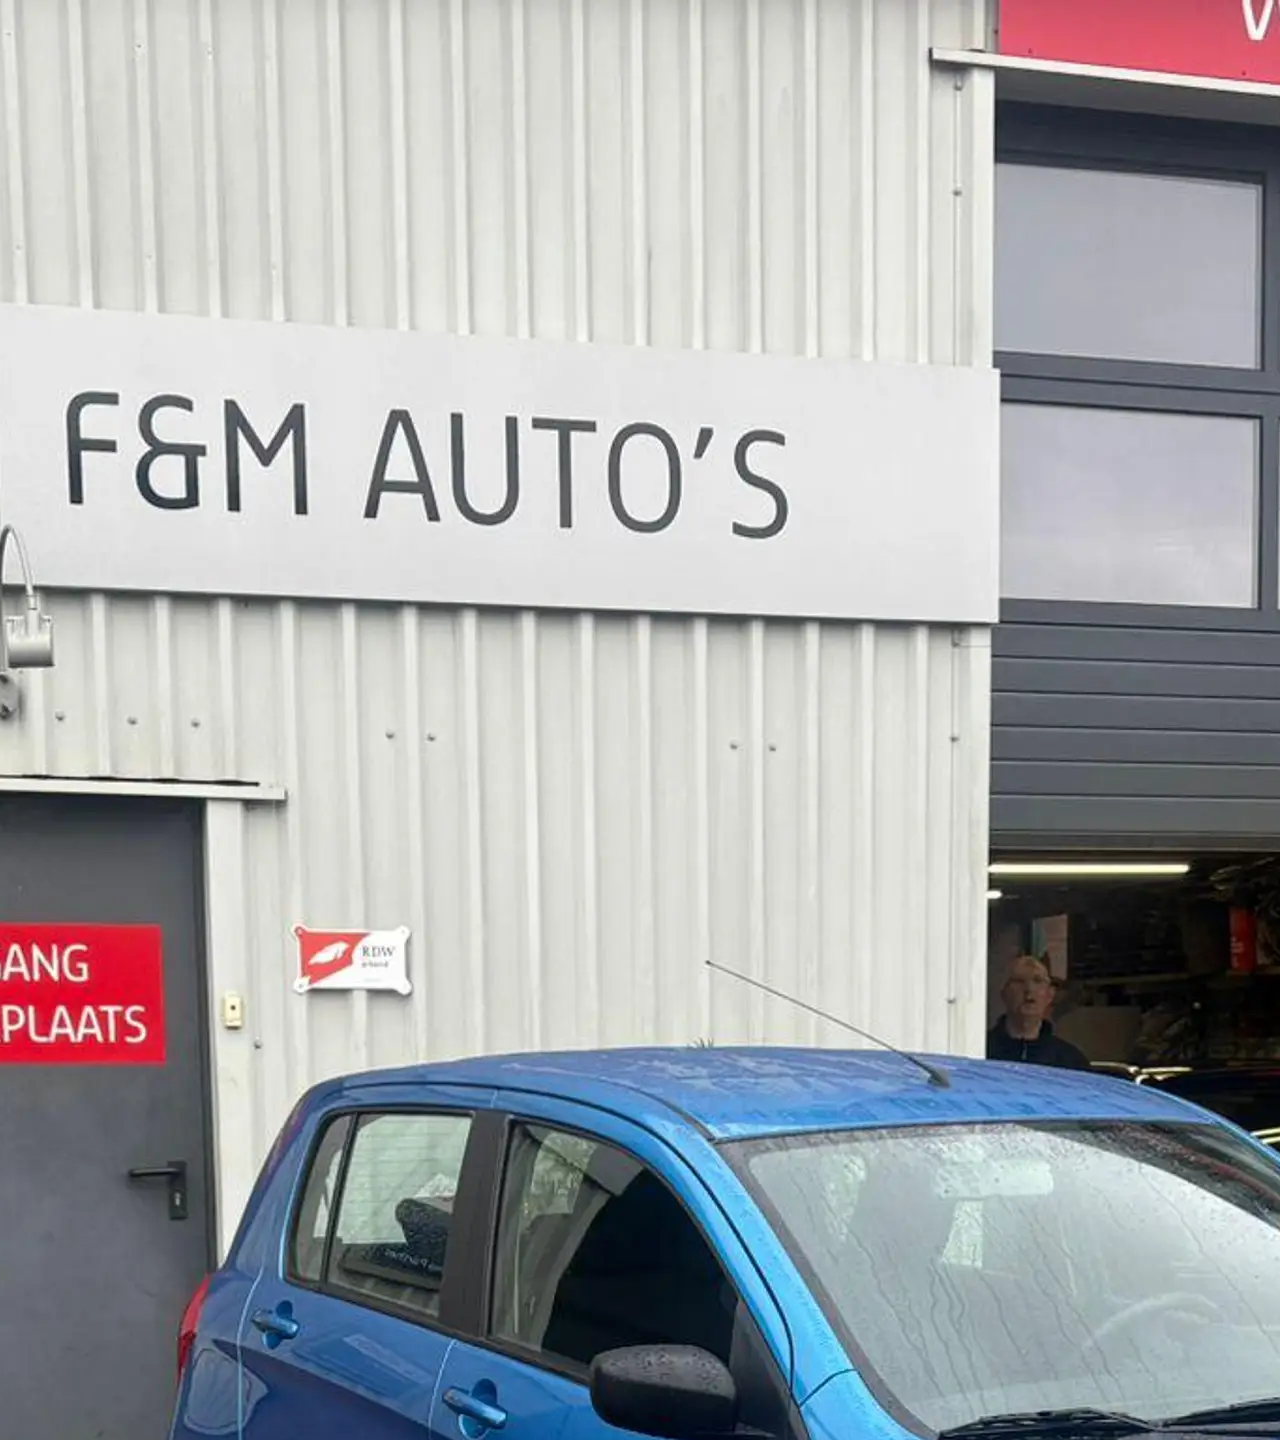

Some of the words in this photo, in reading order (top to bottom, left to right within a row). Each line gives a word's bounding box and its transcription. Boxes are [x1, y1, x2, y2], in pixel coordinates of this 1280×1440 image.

[66, 391, 308, 516] F&M
[365, 409, 788, 539] AUTO'S
[362, 946, 396, 957] RDW
